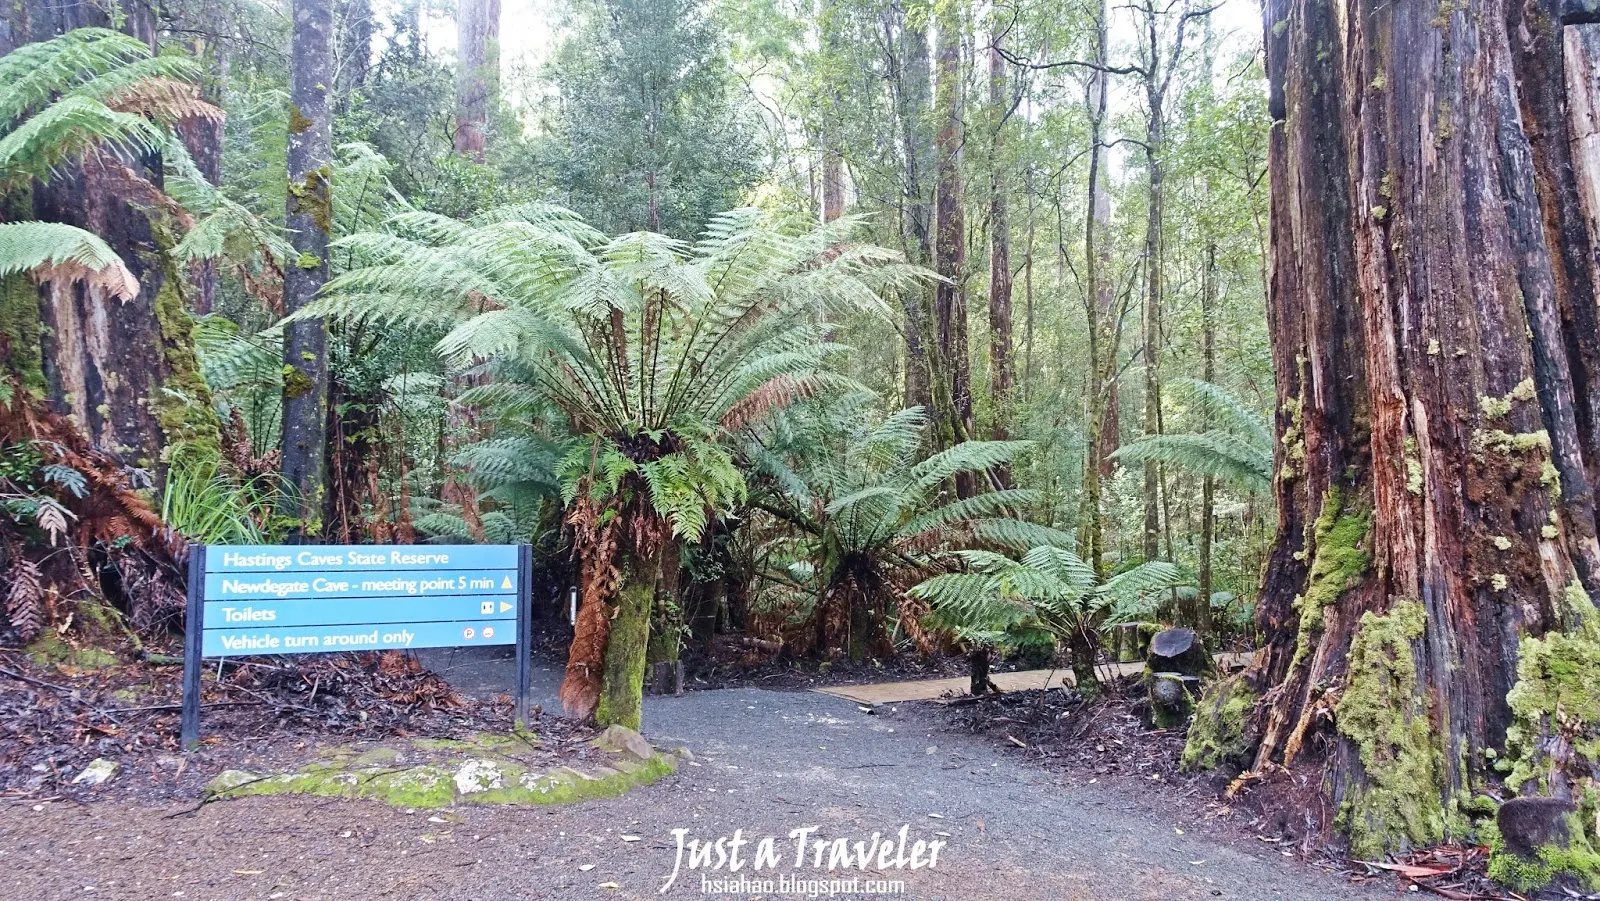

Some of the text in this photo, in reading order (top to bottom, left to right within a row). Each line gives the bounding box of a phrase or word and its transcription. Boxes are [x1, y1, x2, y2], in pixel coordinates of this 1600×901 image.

[223, 551, 449, 570] Hastings Caves State Reserve
[221, 579, 309, 597] Newdegate
[312, 577, 349, 593] Cave
[361, 577, 417, 594] meeting
[419, 577, 455, 594] point
[458, 576, 466, 590] 5
[470, 576, 494, 589] min
[221, 606, 277, 622] Toilets
[221, 629, 415, 650] Vehicle turn around only
